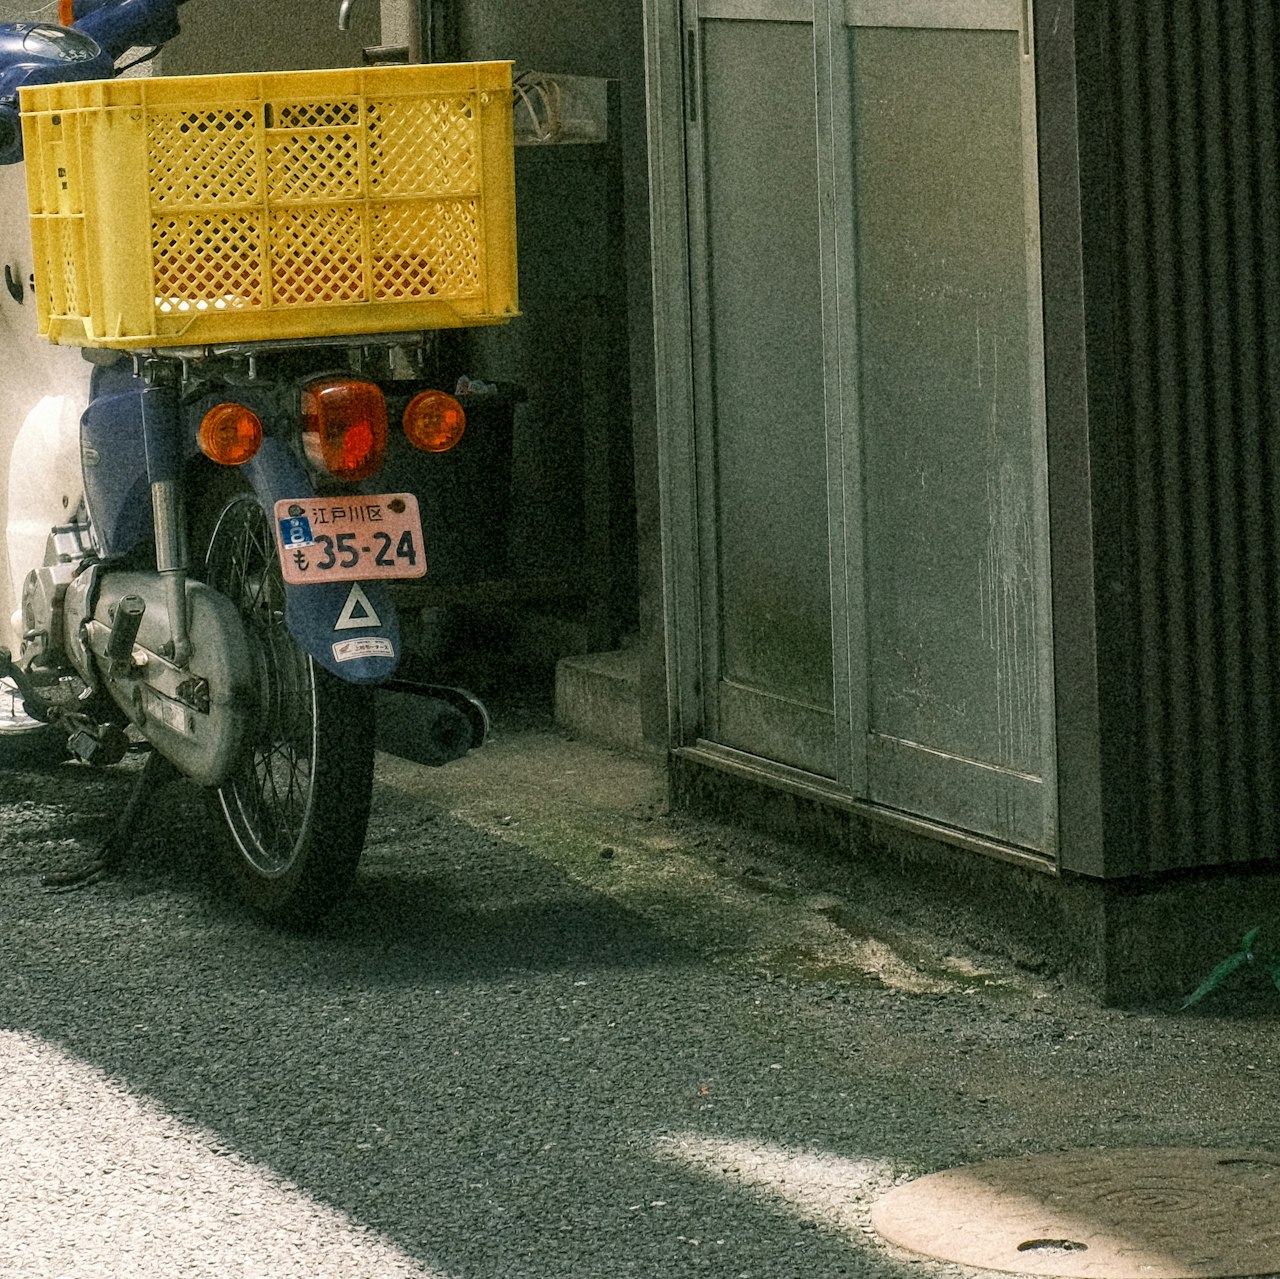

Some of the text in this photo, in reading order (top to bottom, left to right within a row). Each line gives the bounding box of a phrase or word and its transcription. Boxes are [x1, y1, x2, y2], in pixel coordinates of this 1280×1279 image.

[313, 505, 383, 524] 江戸川区
[293, 530, 416, 571] も 35-24
